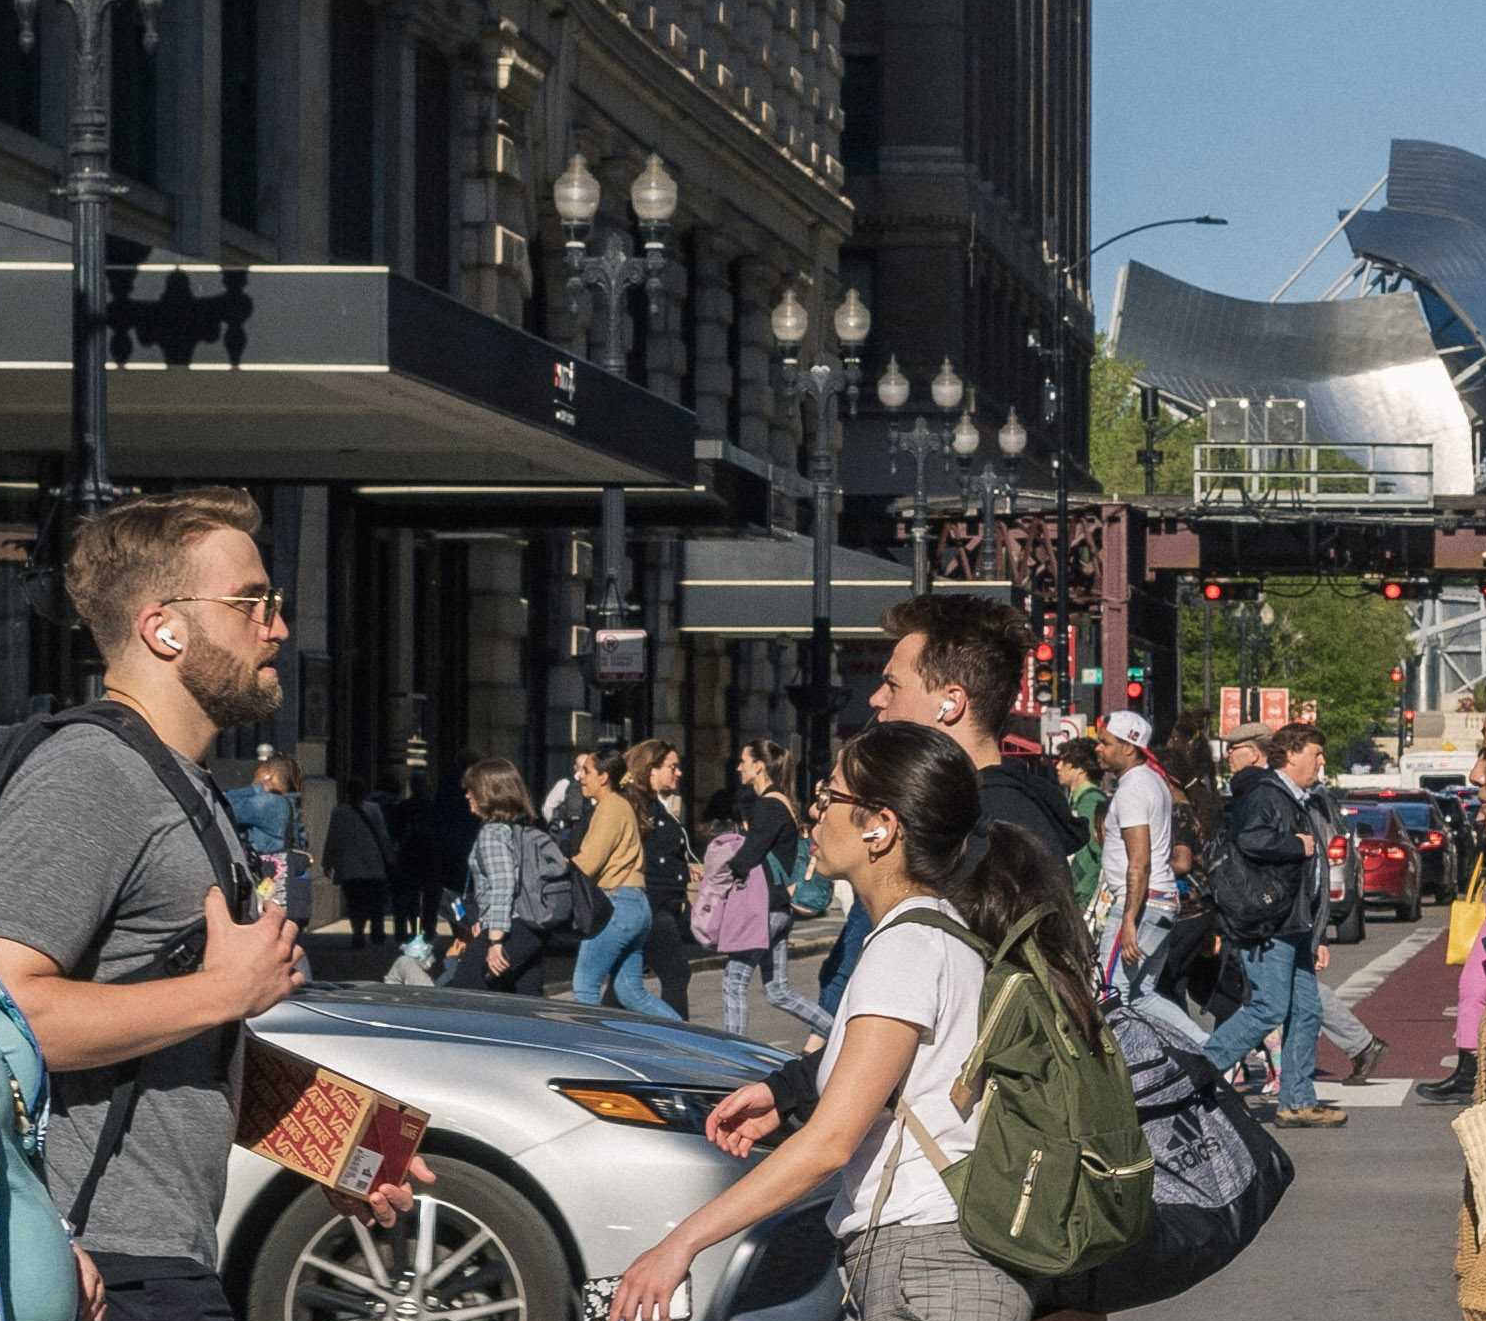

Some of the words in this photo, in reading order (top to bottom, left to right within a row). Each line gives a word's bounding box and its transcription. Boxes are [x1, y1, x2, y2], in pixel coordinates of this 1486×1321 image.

[301, 1107, 333, 1146] VANS
[301, 1137, 333, 1176] VANS
[1166, 1136, 1221, 1173] adidas
